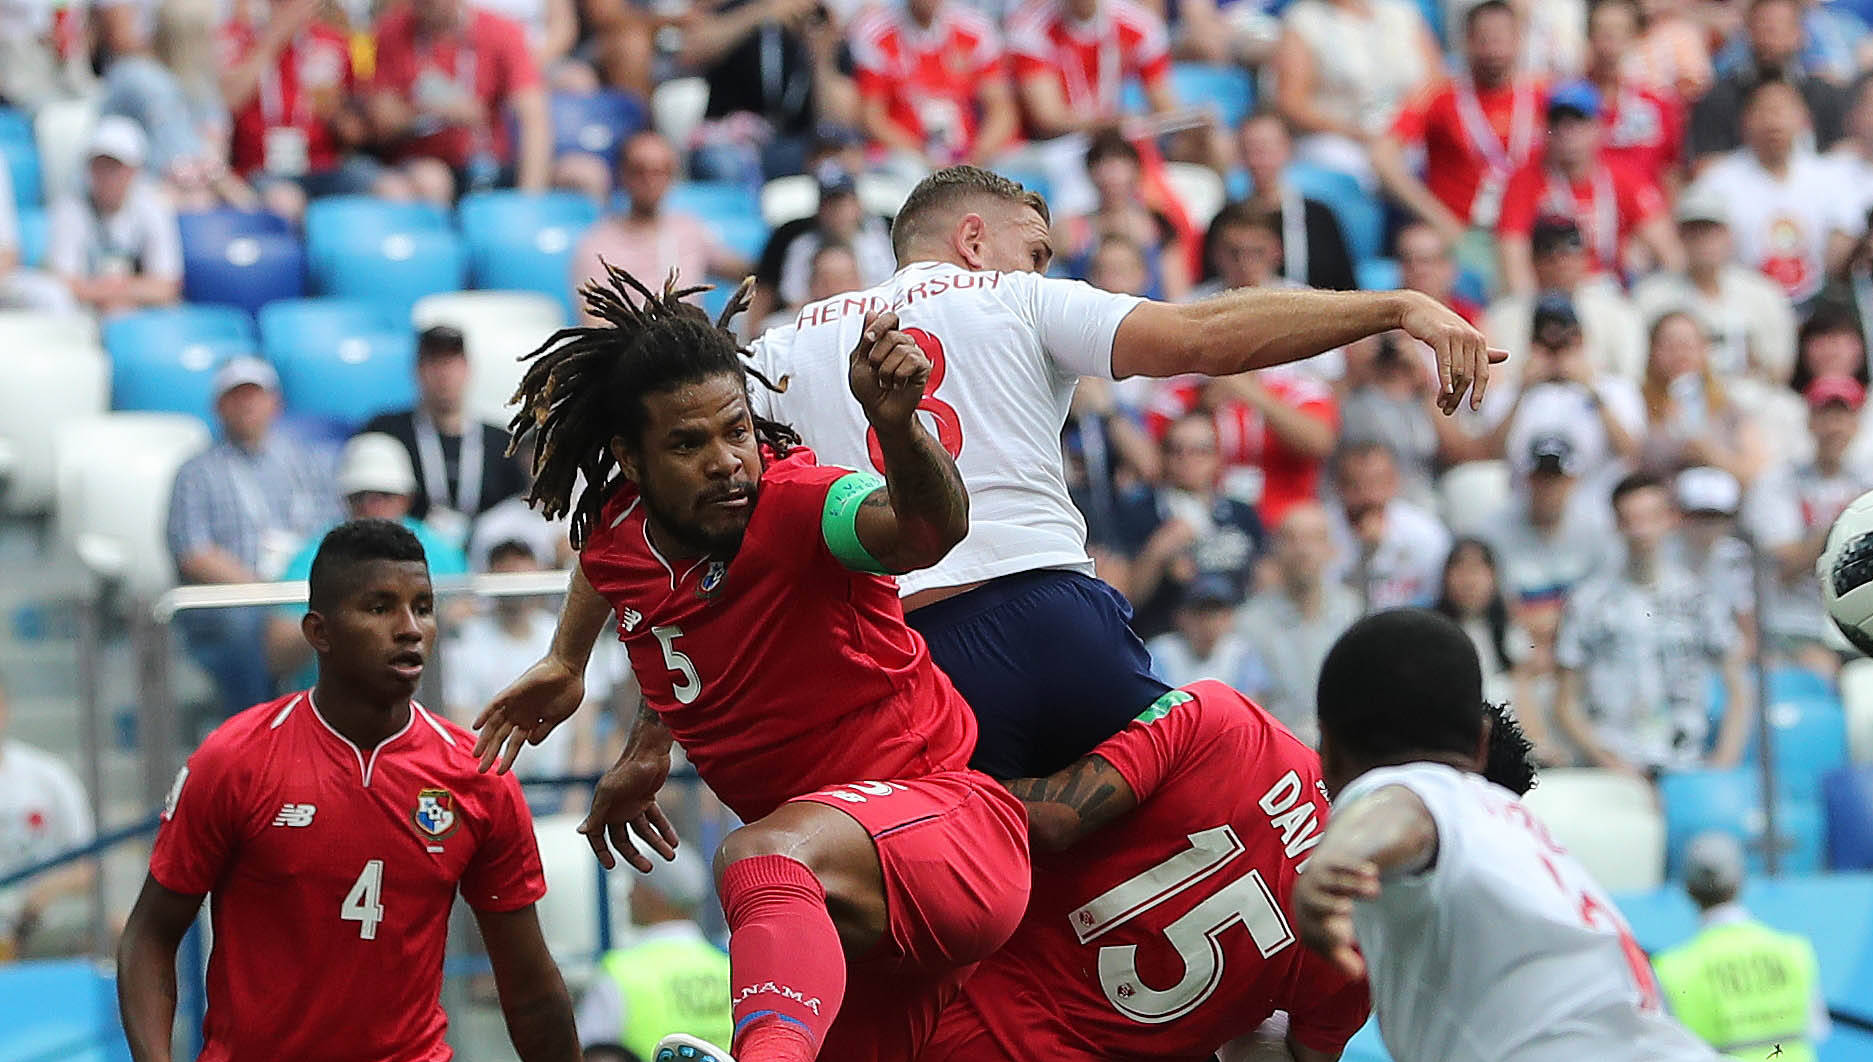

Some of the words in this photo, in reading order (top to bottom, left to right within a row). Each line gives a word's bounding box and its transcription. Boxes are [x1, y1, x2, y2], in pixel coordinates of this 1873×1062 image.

[797, 270, 1000, 330] HENDERSON
[865, 327, 963, 476] 8
[651, 626, 701, 704] 5
[341, 859, 384, 940] 4
[1068, 824, 1296, 1024] 15
